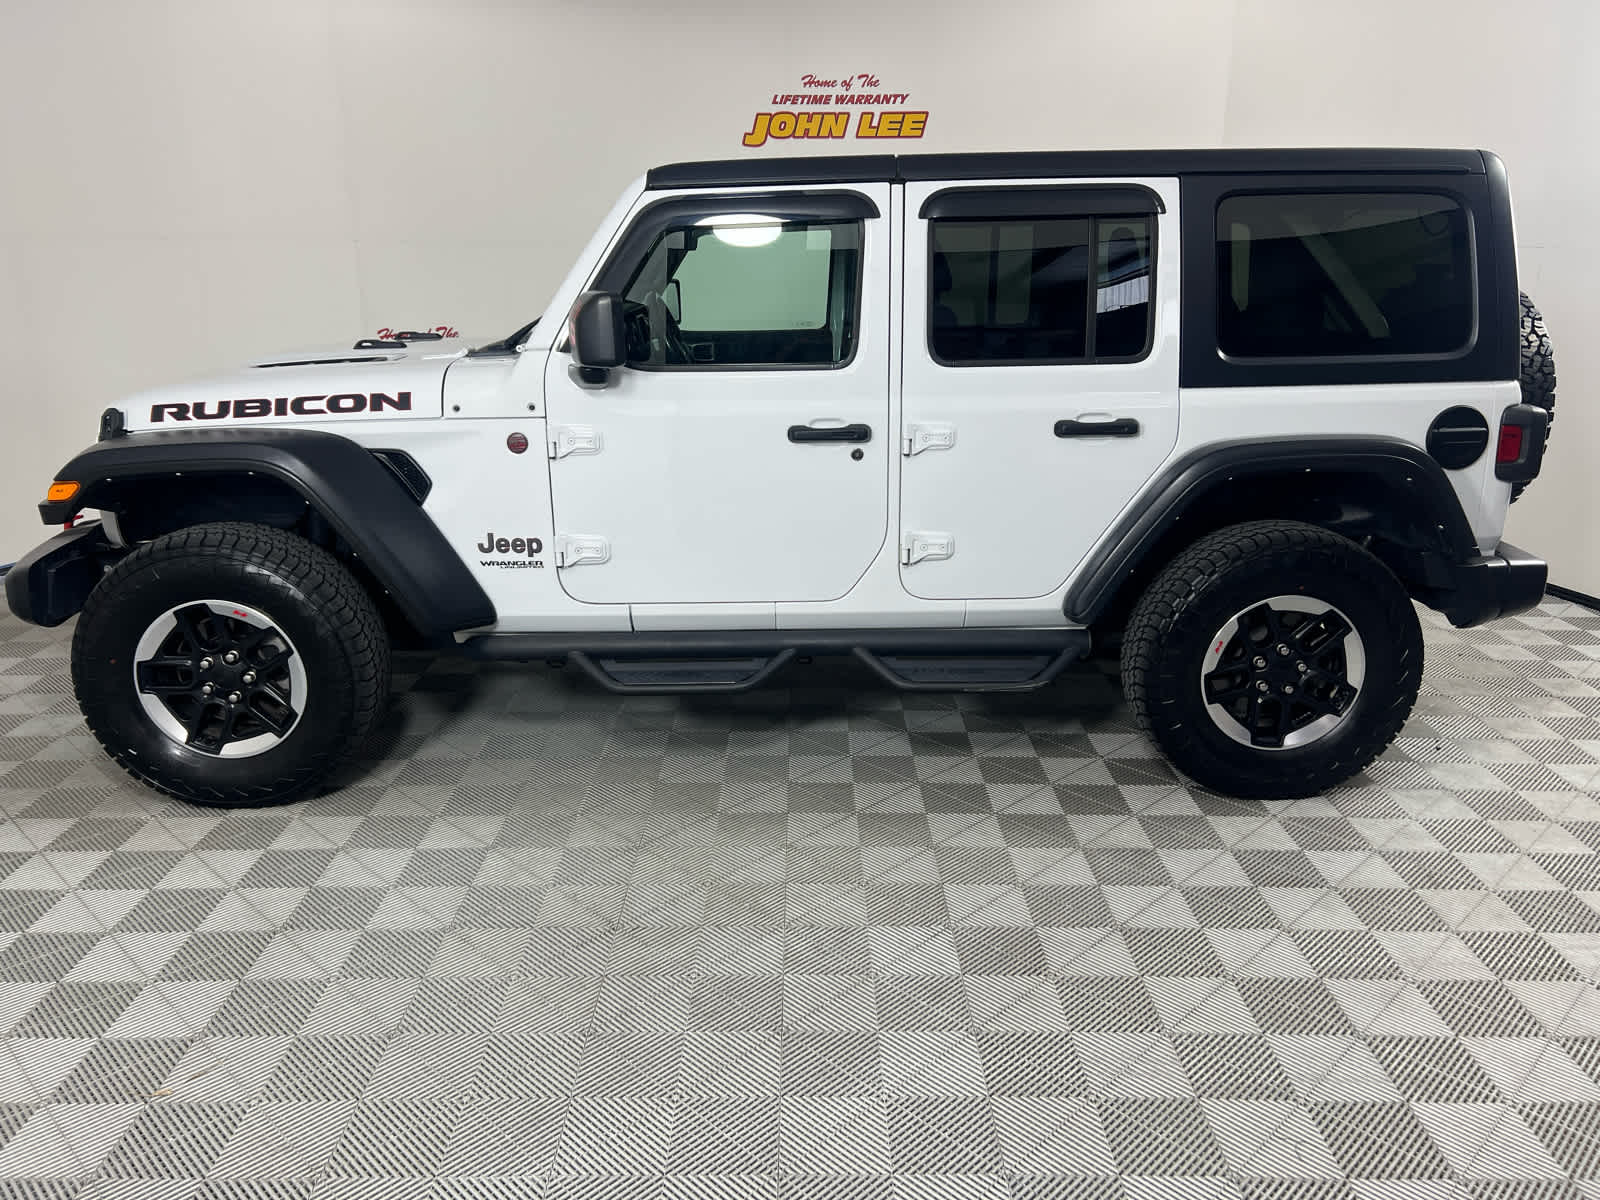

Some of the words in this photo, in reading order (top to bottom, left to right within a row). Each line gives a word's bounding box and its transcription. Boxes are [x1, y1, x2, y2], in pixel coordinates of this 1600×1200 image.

[801, 74, 837, 88] Home
[841, 76, 854, 91] of
[857, 74, 880, 88] The
[772, 94, 832, 105] LIFETIME
[835, 93, 909, 105] WARRANTY
[742, 111, 850, 147] JOHN
[856, 111, 929, 138] LEE
[150, 391, 412, 423] RUBICON
[477, 532, 543, 557] Jeep
